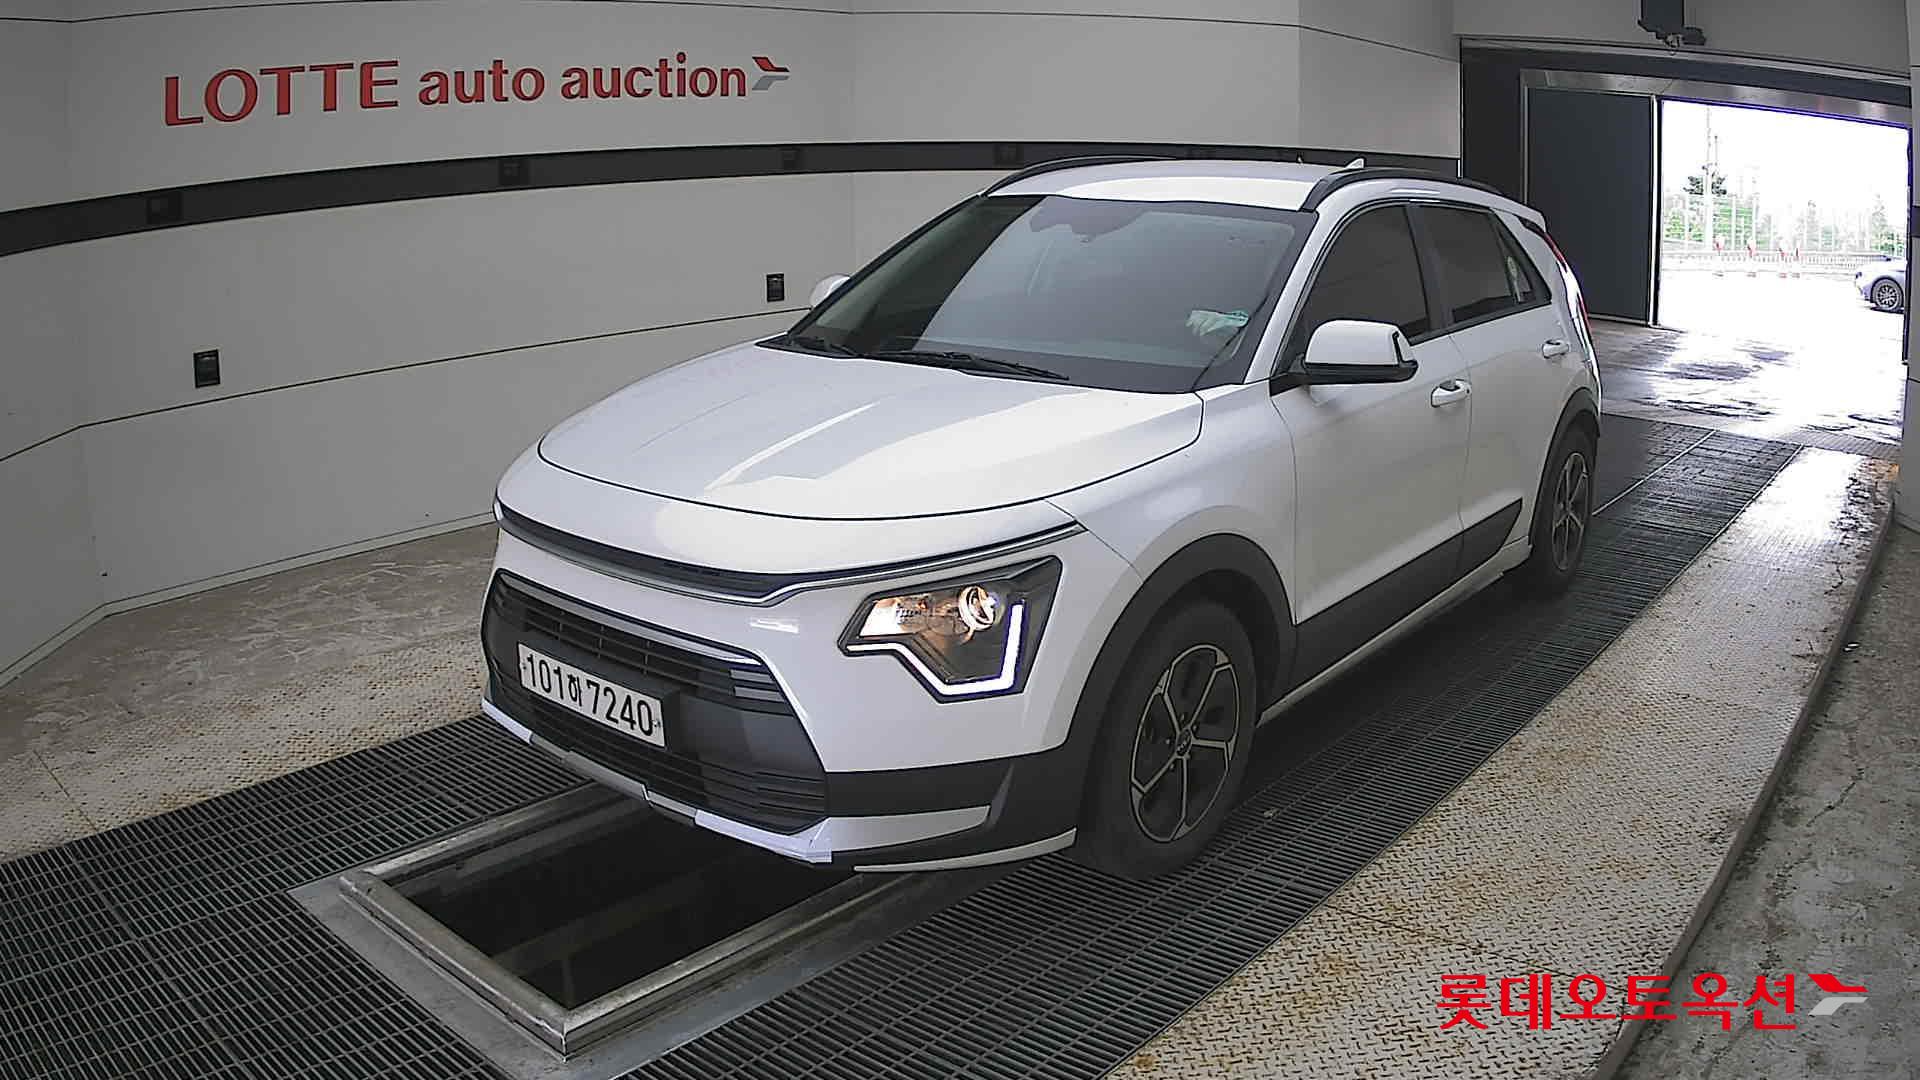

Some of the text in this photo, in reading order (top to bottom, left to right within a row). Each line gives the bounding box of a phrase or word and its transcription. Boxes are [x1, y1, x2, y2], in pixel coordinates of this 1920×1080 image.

[164, 51, 748, 126] LOTTE auto auction
[526, 653, 654, 737] 101하7240
